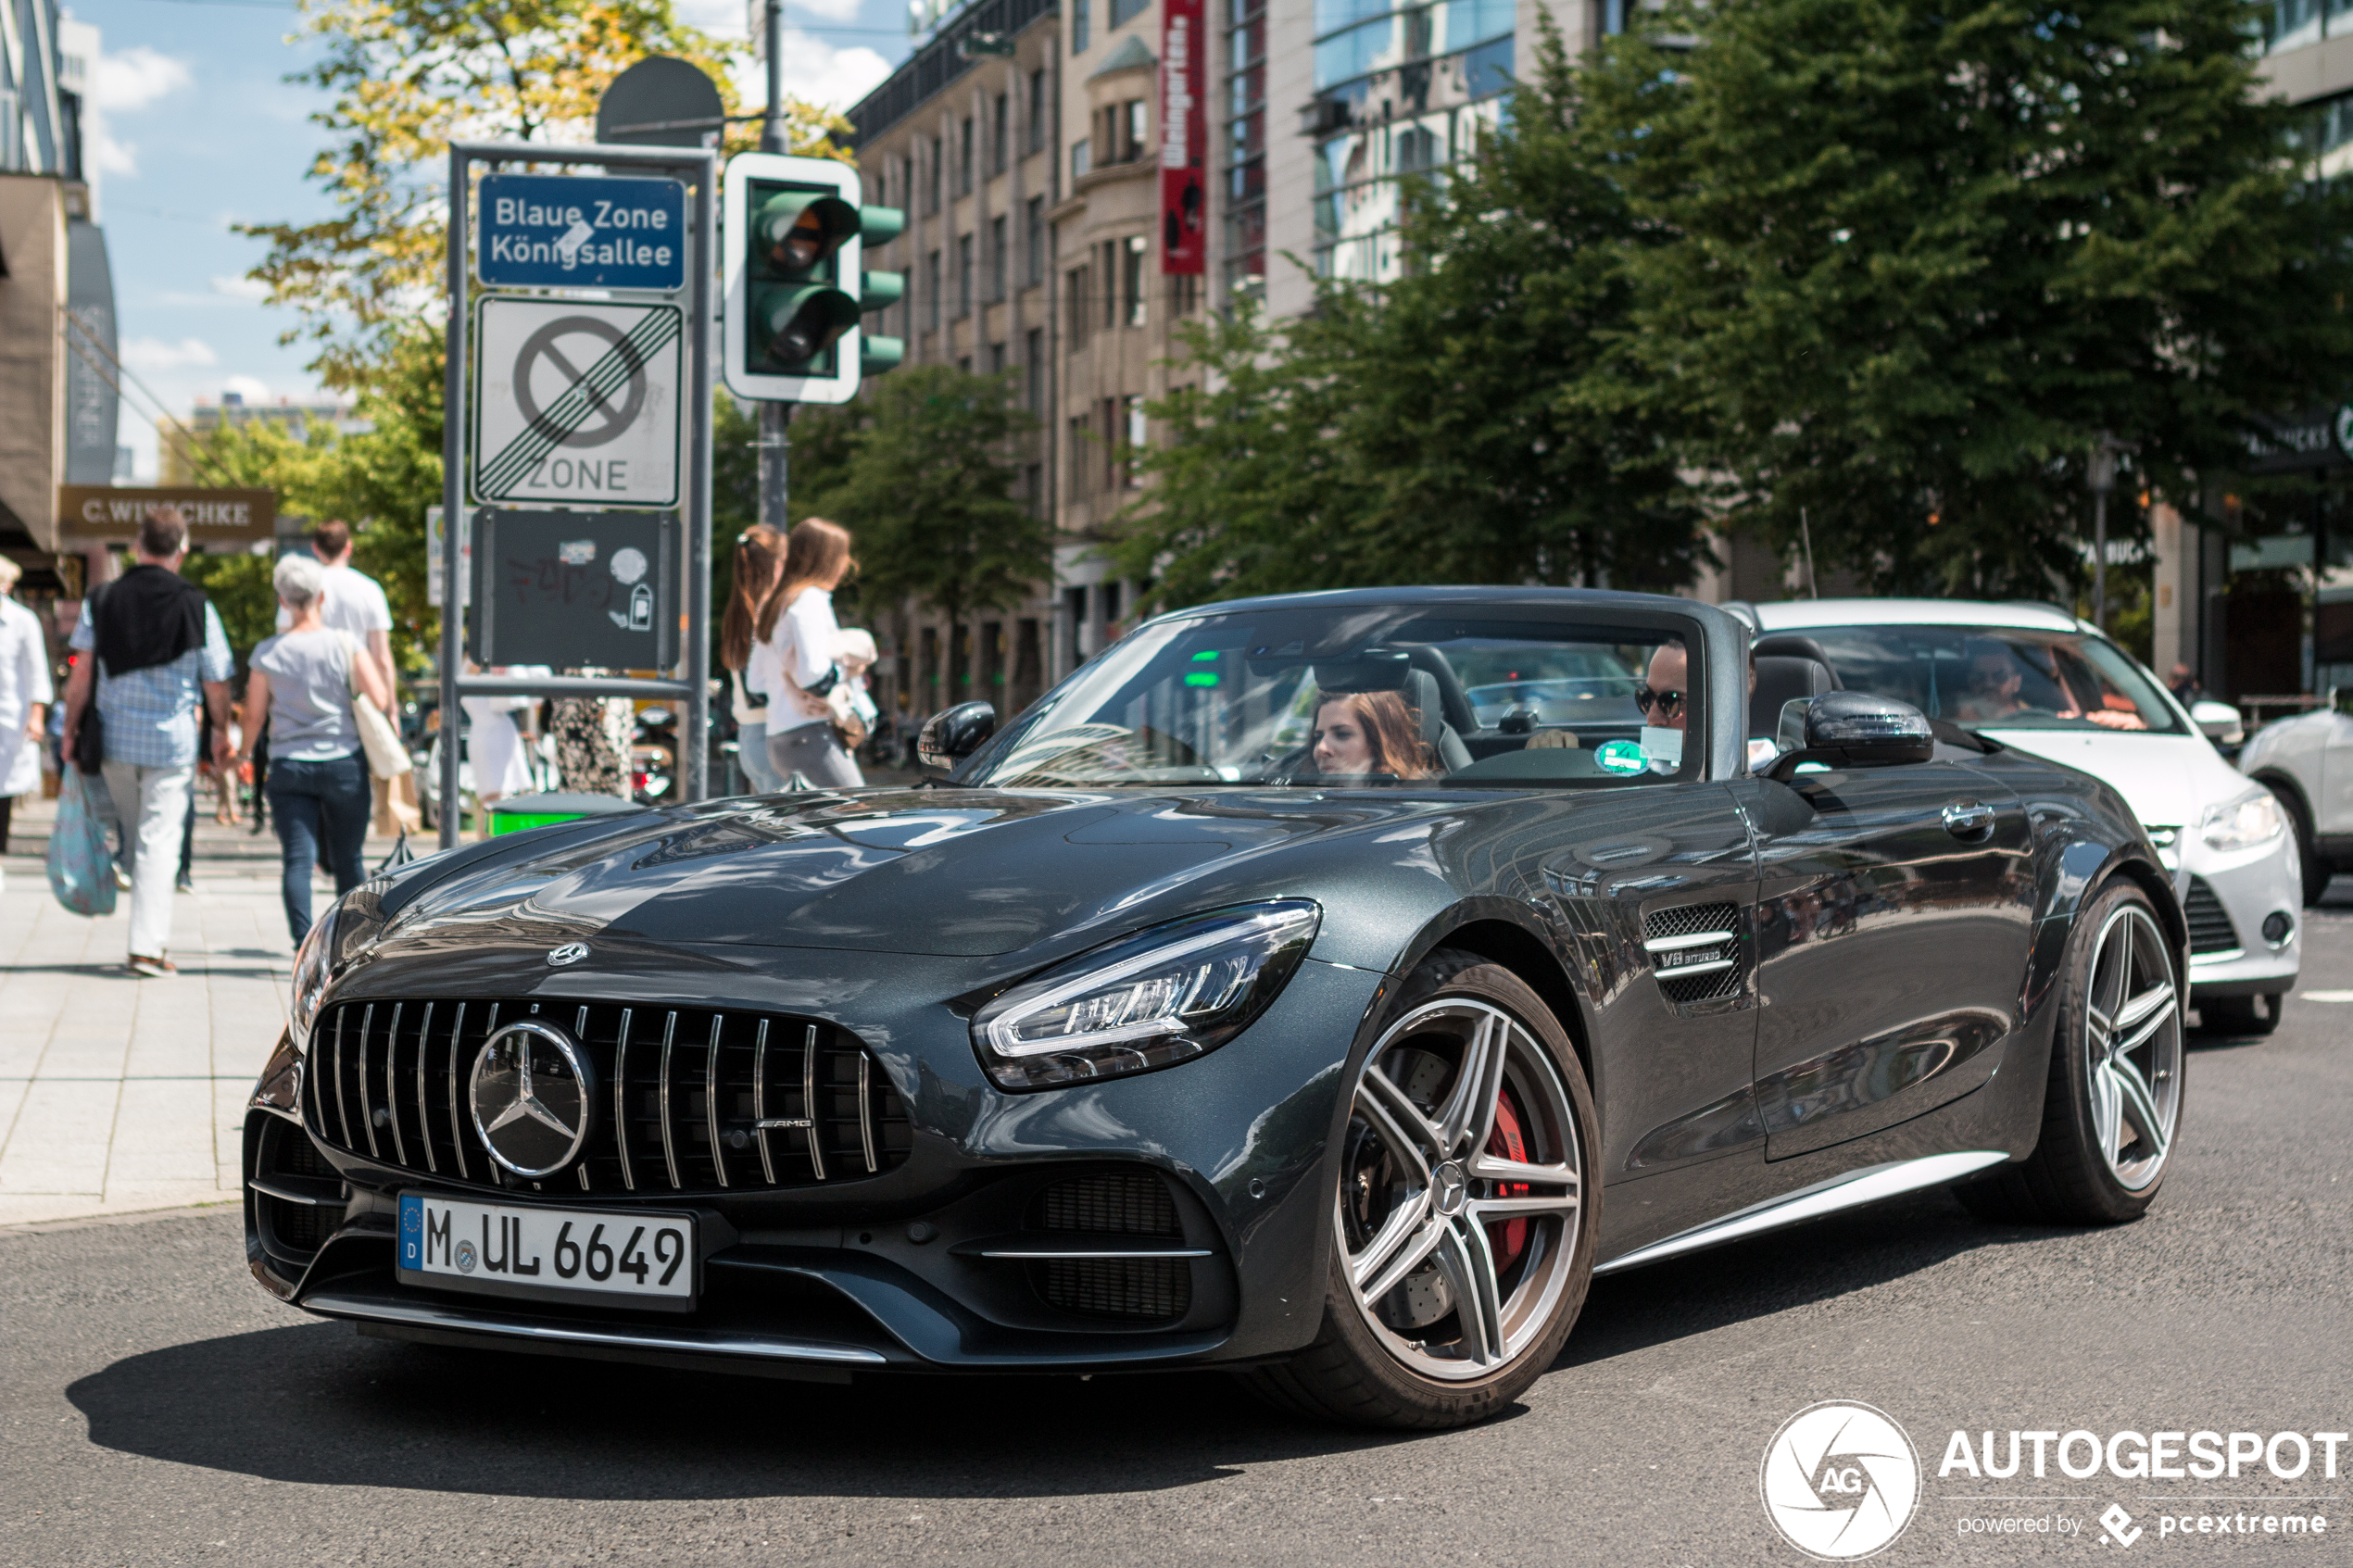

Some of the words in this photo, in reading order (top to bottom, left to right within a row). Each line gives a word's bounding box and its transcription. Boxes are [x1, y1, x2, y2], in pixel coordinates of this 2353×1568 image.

[496, 197, 583, 226] Blaue
[594, 200, 668, 230] Zone
[528, 458, 627, 491] ZONE
[1617, 746, 1631, 759] 4
[1661, 951, 1683, 968] V8
[1684, 950, 1721, 964] BITURBO
[772, 1120, 812, 1128] AMG
[408, 1242, 417, 1260] D
[426, 1208, 451, 1267] M
[482, 1213, 541, 1276] UL
[554, 1221, 686, 1287] 6649
